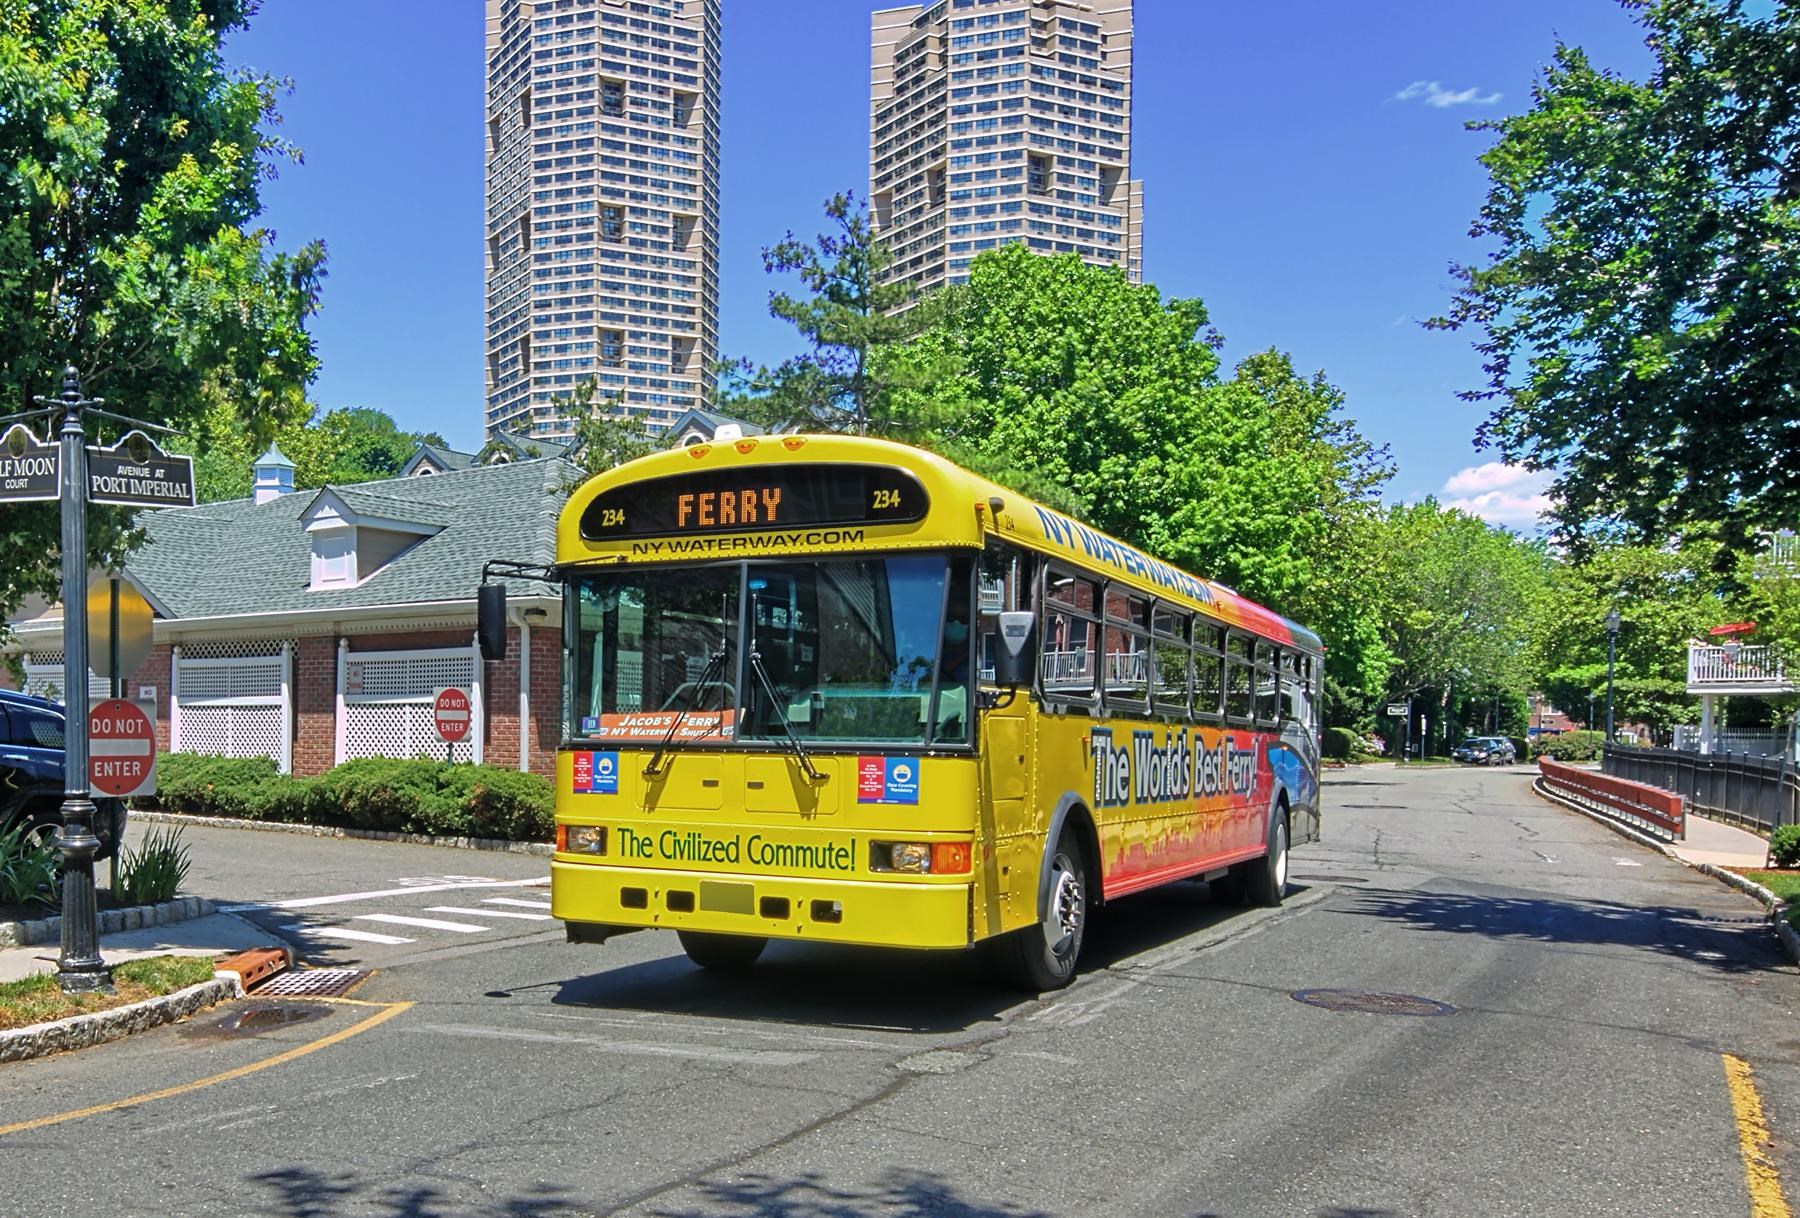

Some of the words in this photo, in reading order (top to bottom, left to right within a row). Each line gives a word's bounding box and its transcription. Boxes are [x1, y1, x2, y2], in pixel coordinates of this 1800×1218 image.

[14, 457, 56, 477] MOON
[117, 465, 150, 478] AVENUE
[154, 469, 165, 479] AT
[5, 478, 29, 490] COURT
[92, 475, 128, 494] PORT
[130, 481, 191, 499] IMPERIAL
[677, 487, 782, 528] FERRY
[873, 489, 901, 510] 234
[602, 508, 625, 527] 234
[632, 543, 664, 556] NY
[667, 530, 865, 552] WATERWAY.COM
[1033, 505, 1076, 549] NY
[1074, 525, 1216, 606] WATERWAY.COM
[440, 698, 450, 708] DO
[451, 698, 465, 708] NOT
[92, 718, 111, 734] DO
[116, 718, 144, 734] NOT
[441, 722, 464, 732] ENTER
[611, 727, 628, 736] NY
[94, 761, 141, 777] ENTER
[1091, 728, 1131, 804] The
[1133, 728, 1190, 802] World's
[1194, 735, 1223, 796] Best
[1225, 737, 1259, 800] Ferry!
[617, 828, 653, 858] The
[659, 830, 741, 864] Civilized
[747, 835, 857, 872] Commute!
